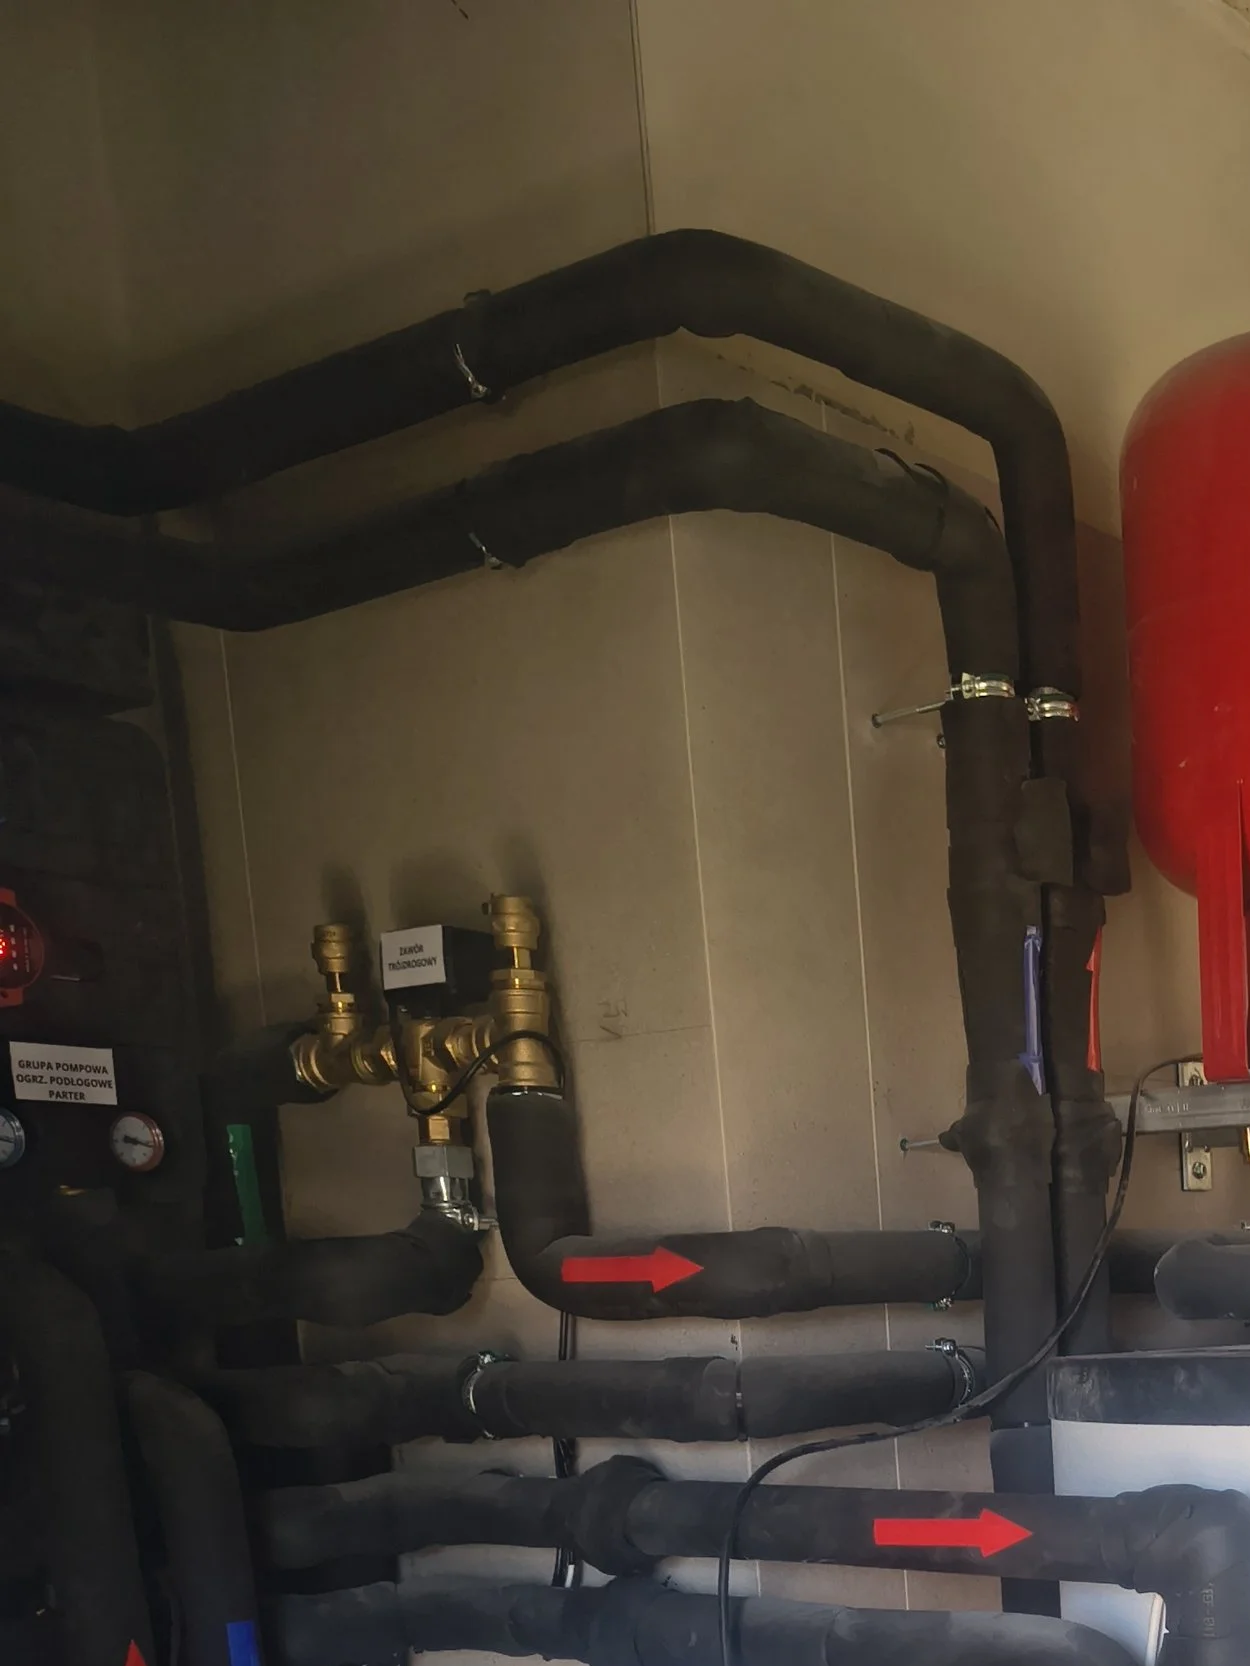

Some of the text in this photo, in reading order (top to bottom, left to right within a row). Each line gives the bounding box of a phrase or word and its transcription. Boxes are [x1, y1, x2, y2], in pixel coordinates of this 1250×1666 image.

[18, 1059, 109, 1075] GRUPA POMPOWA
[16, 1074, 48, 1085] OGRZ.
[48, 1090, 86, 1101] PARTER
